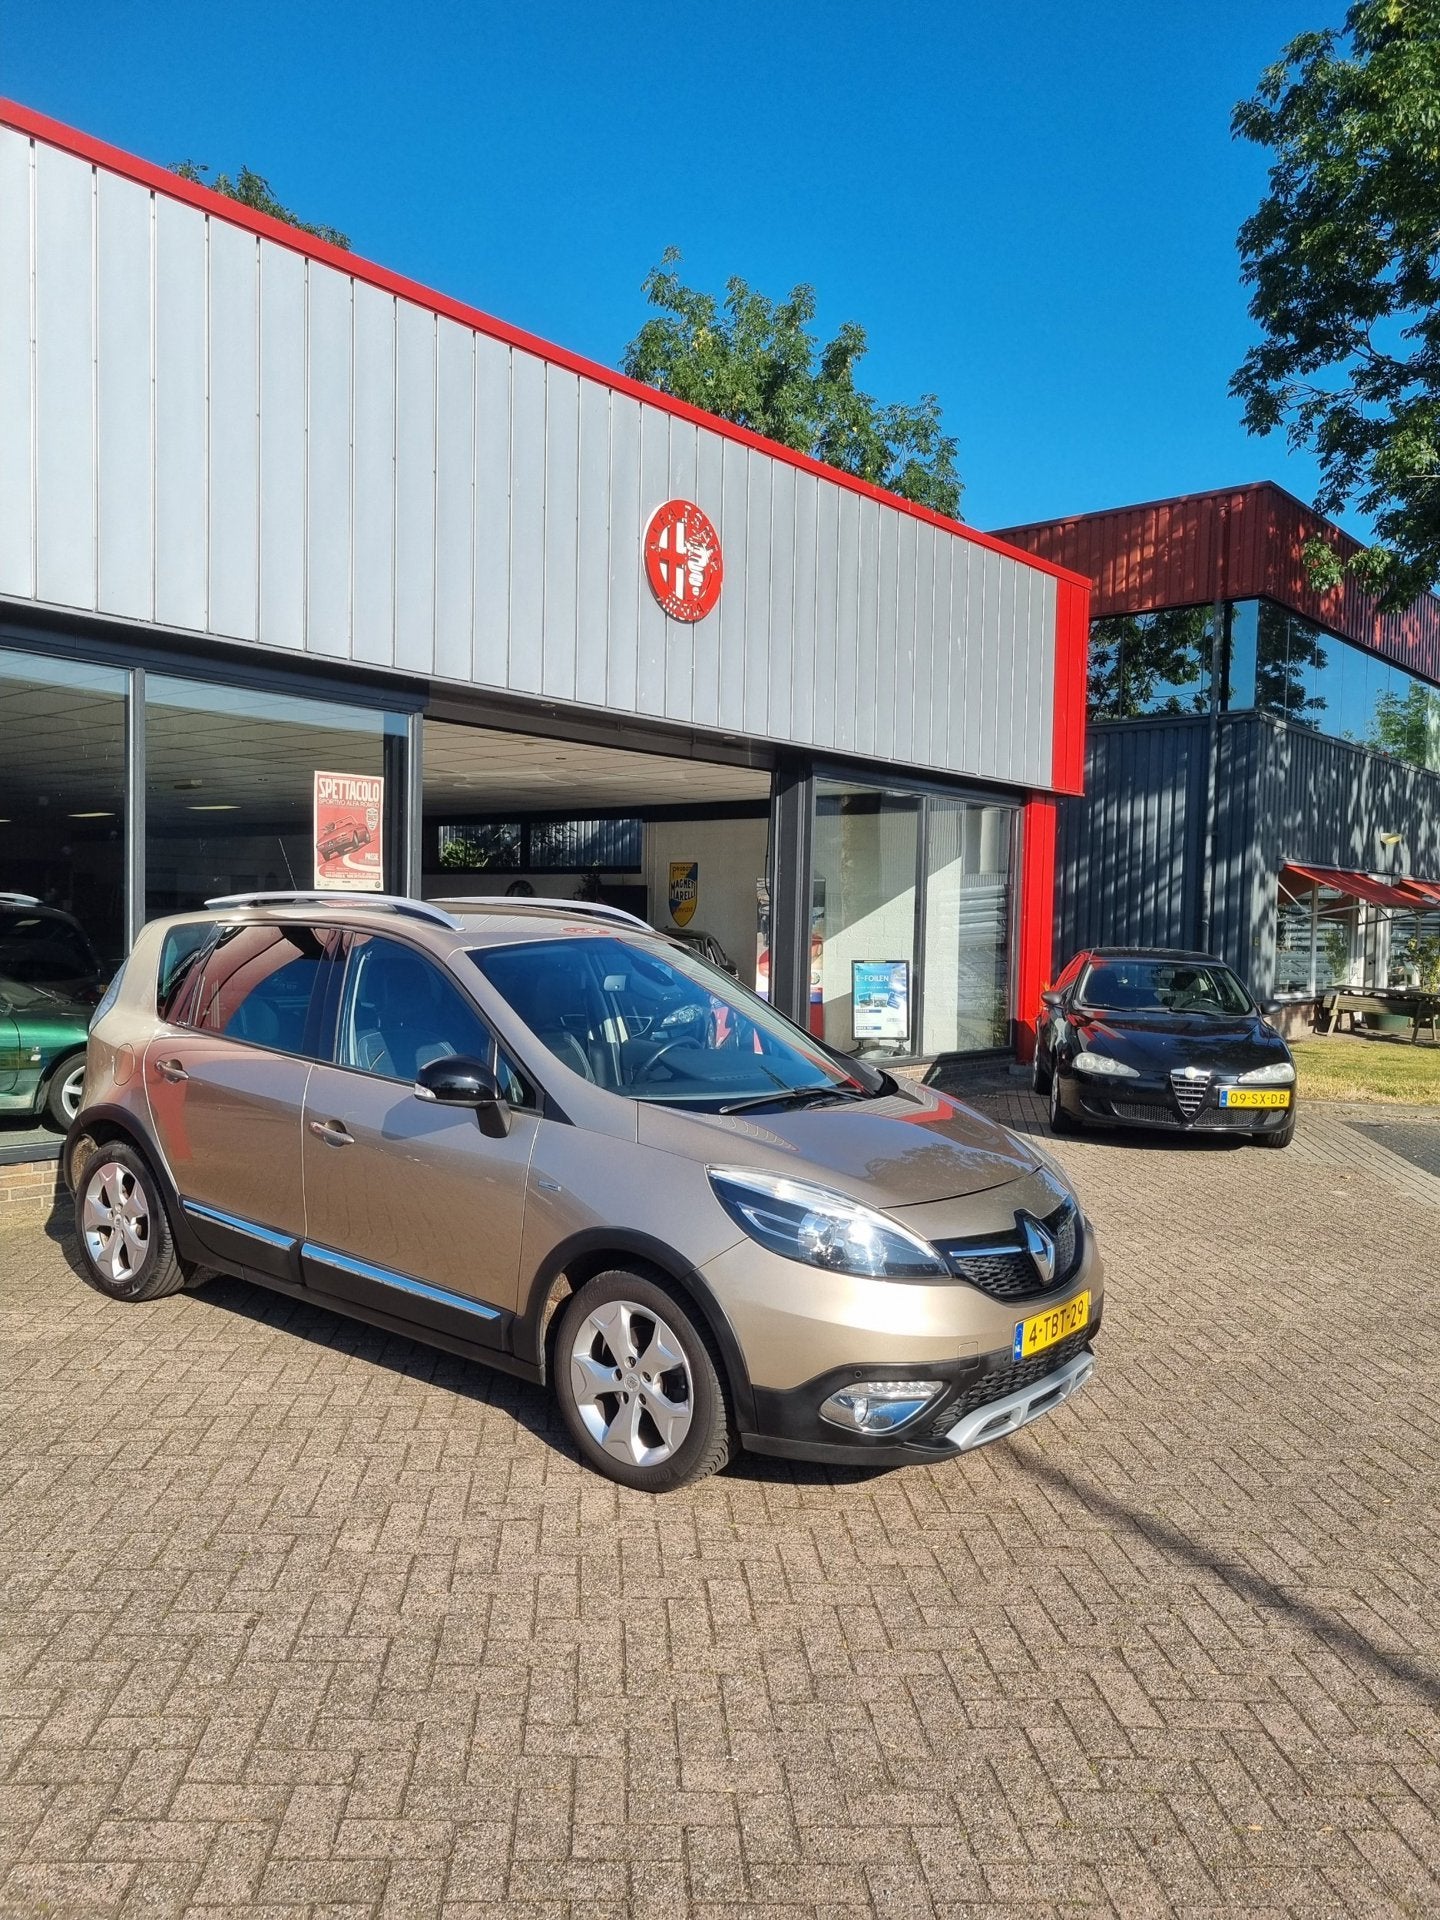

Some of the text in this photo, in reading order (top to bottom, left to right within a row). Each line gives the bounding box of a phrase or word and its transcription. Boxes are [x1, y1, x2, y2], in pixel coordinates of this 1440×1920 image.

[319, 777, 380, 802] SPETTACOLO
[346, 799, 360, 807] ALFA
[1029, 1300, 1084, 1347] 4-TBT-29
